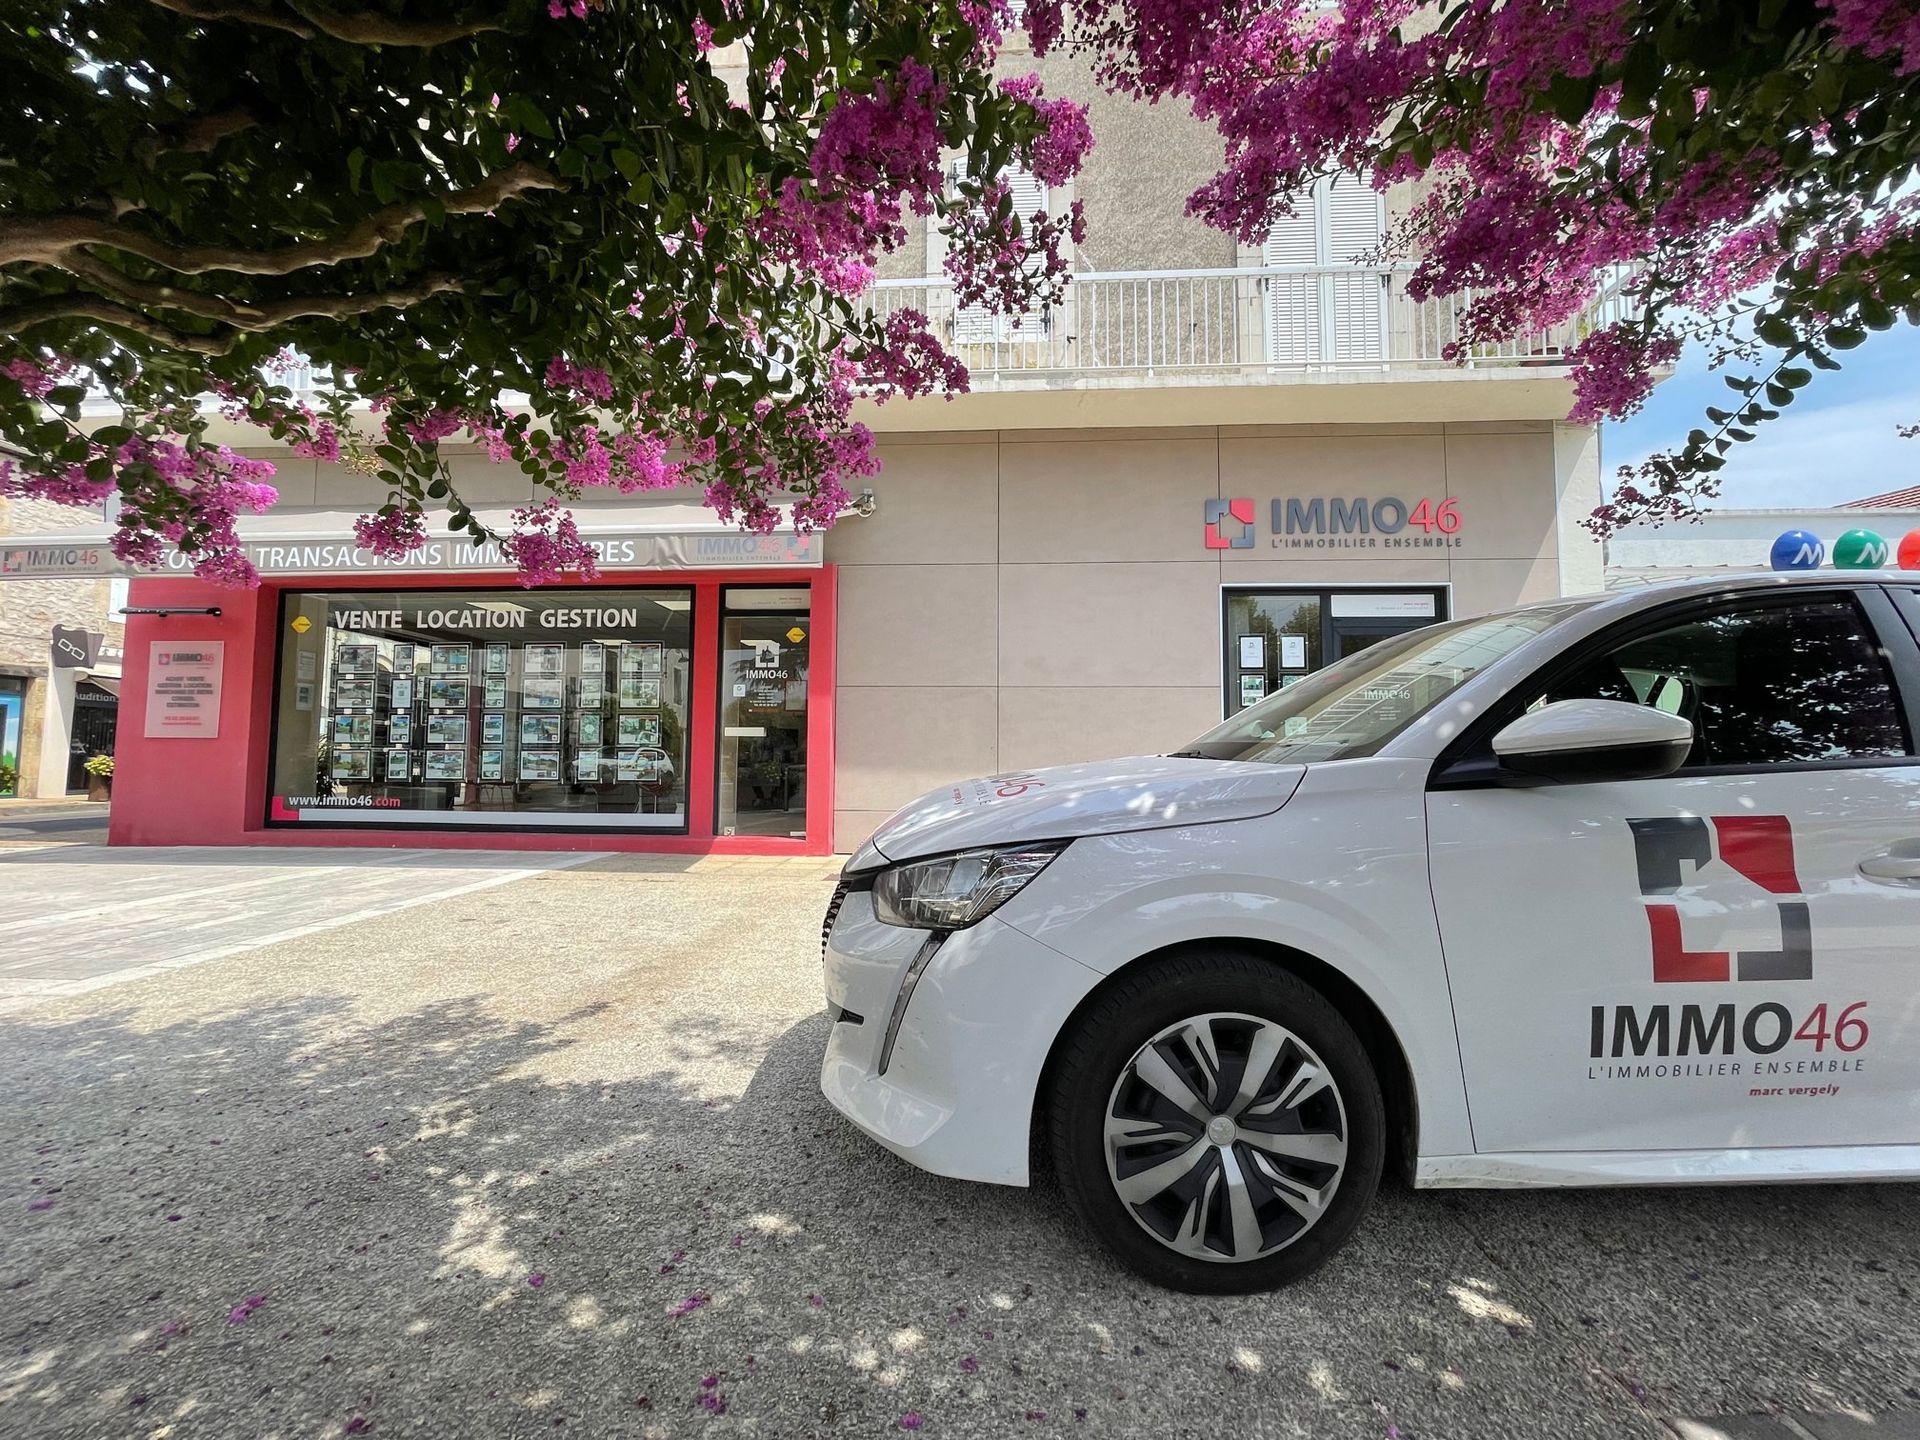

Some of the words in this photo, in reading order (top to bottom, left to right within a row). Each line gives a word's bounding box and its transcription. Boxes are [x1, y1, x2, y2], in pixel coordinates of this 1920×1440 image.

[1271, 497, 1462, 534] IMMO46
[697, 537, 779, 554] IMMO46
[1272, 539, 1376, 548] L'IMMOBILIER
[1385, 537, 1462, 547] ENSEMBLE
[27, 550, 98, 566] IMMO46
[455, 541, 635, 565] IMMRES
[335, 611, 402, 629] VENTE
[417, 609, 525, 629] LOCATION
[540, 608, 637, 628] GESTION
[746, 670, 788, 679] IMMO46
[288, 794, 401, 807] www.immo46.com
[1590, 1001, 1869, 1058] IMMO46
[1588, 1064, 1742, 1080] L'IMMOBILIER
[1754, 1059, 1865, 1075] ENSEMBLE
[1750, 1087, 1783, 1096] marc
[1788, 1084, 1840, 1097] vergely
